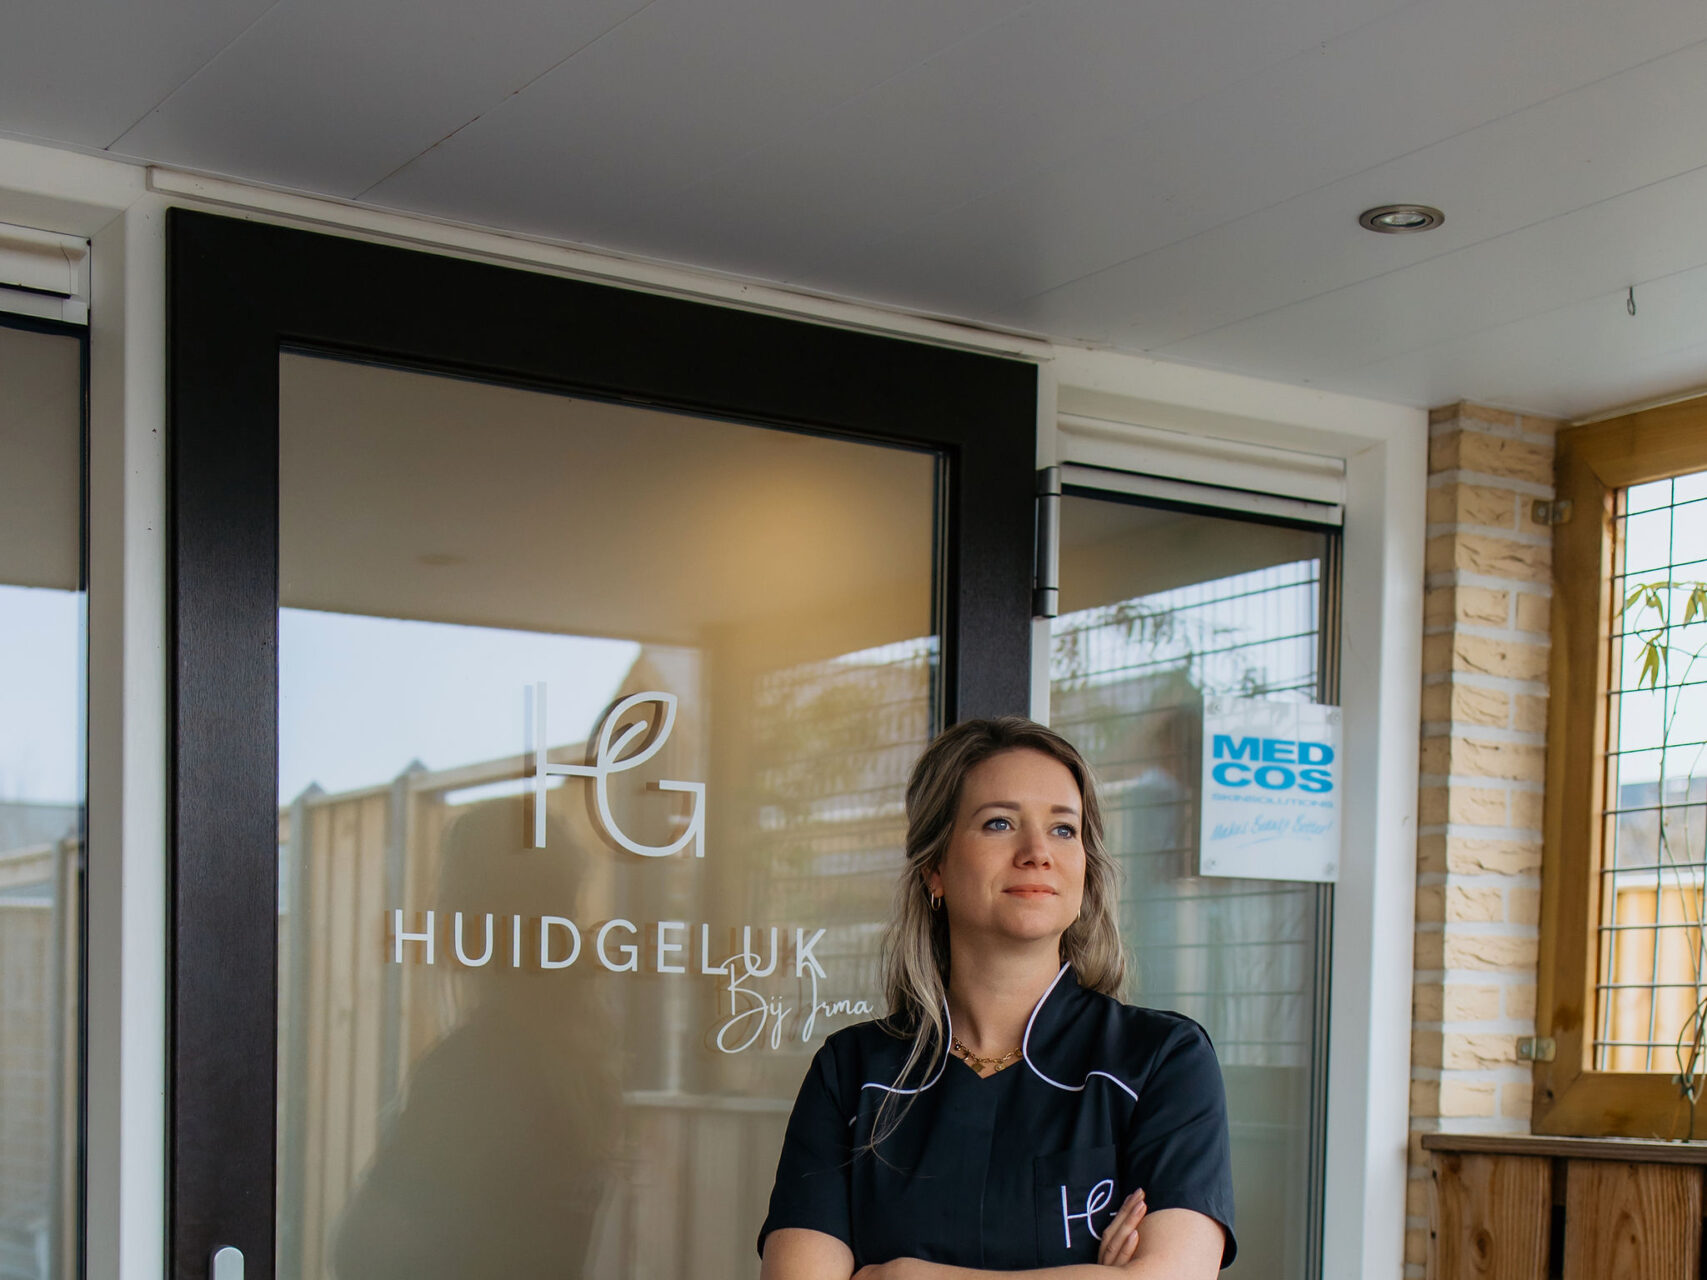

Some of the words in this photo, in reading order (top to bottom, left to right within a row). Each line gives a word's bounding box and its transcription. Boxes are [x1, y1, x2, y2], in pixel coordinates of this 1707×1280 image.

[1213, 734, 1335, 766] MED
[1212, 762, 1334, 794] COS
[394, 909, 828, 980] HUIDGELUK
